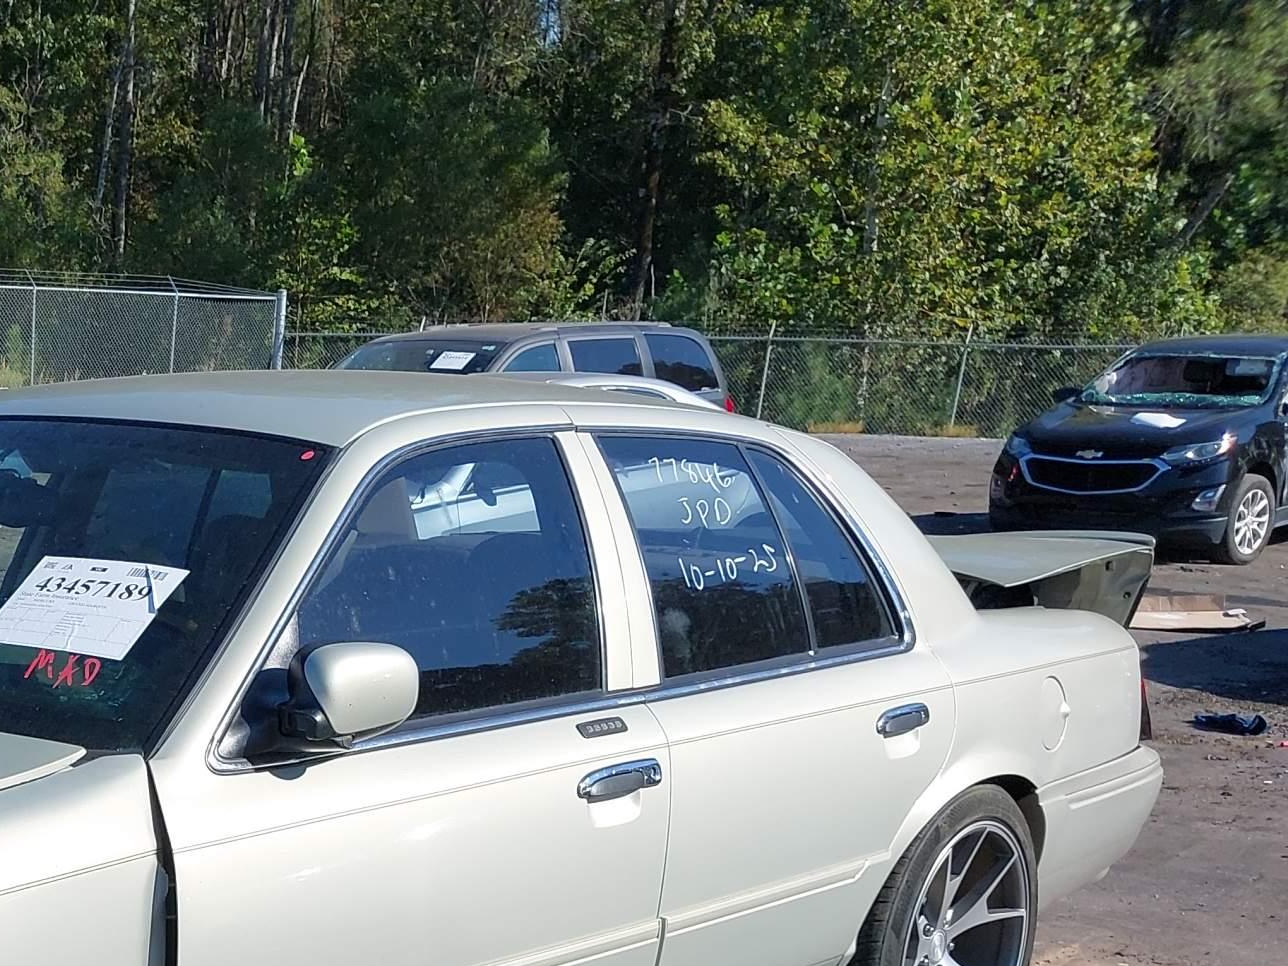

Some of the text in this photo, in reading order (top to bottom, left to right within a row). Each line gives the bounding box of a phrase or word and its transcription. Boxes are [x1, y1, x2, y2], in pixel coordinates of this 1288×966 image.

[678, 497, 732, 528] JPD
[679, 544, 778, 591] 10-10-25
[35, 576, 153, 601] 43457189
